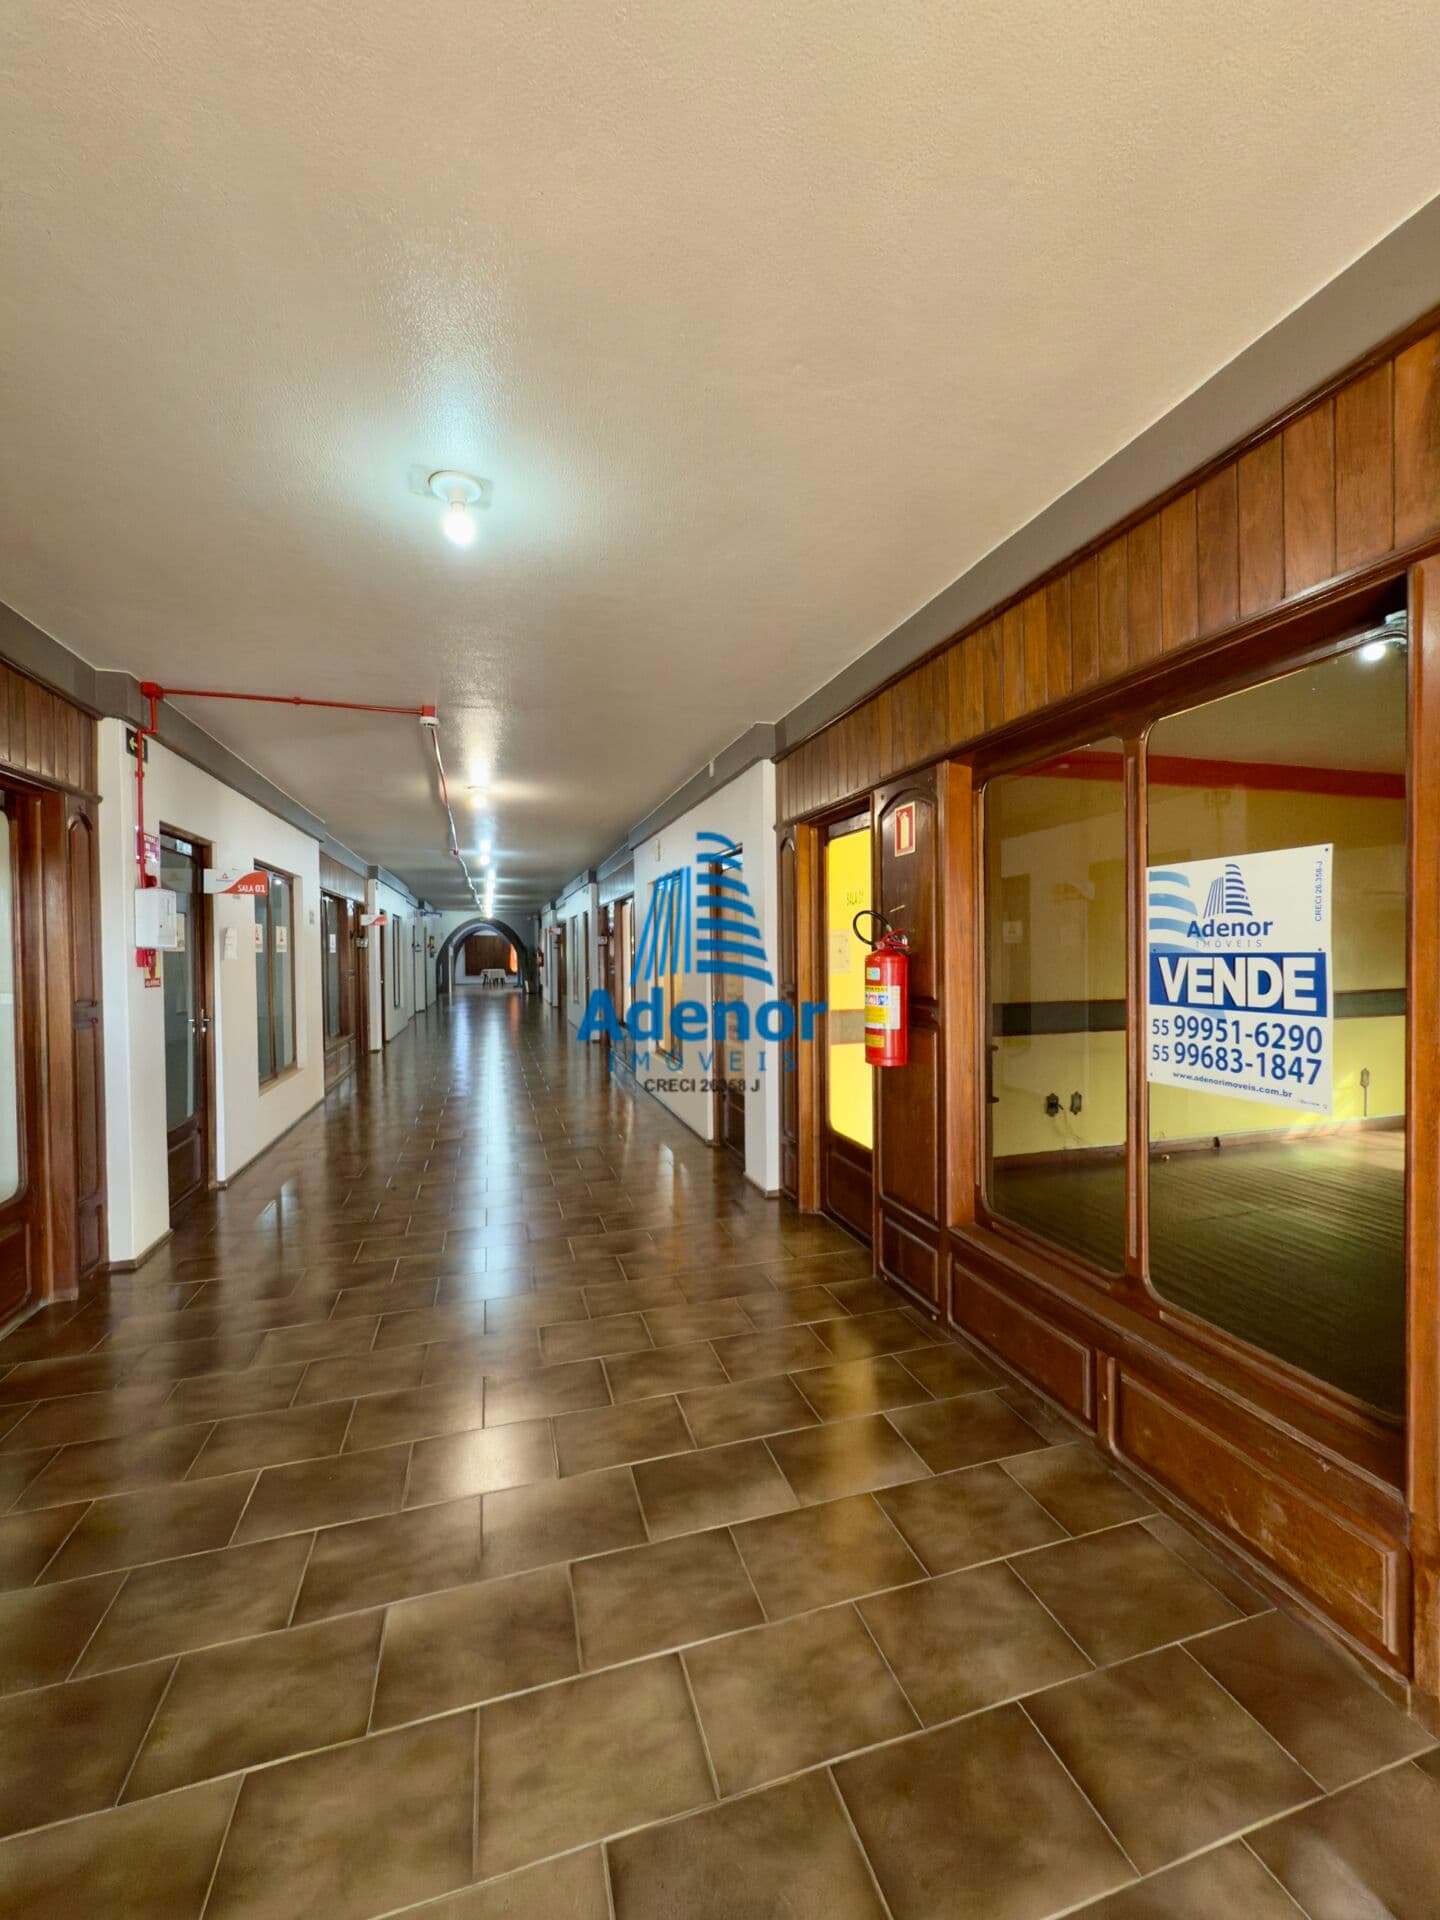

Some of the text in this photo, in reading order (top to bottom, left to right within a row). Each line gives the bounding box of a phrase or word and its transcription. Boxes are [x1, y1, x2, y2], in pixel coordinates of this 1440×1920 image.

[237, 884, 266, 893] SALA 01
[1314, 896, 1322, 921] CRECI
[1186, 918, 1274, 938] Adenor
[1195, 938, 1263, 948] IMÓVEIS
[1158, 956, 1318, 1012] VENDE
[1152, 1014, 1323, 1054] 55 99951-6290
[1152, 1041, 1323, 1085] 55 99683-1847
[1172, 1071, 1293, 1099] www.adenorimoveis.com.br
